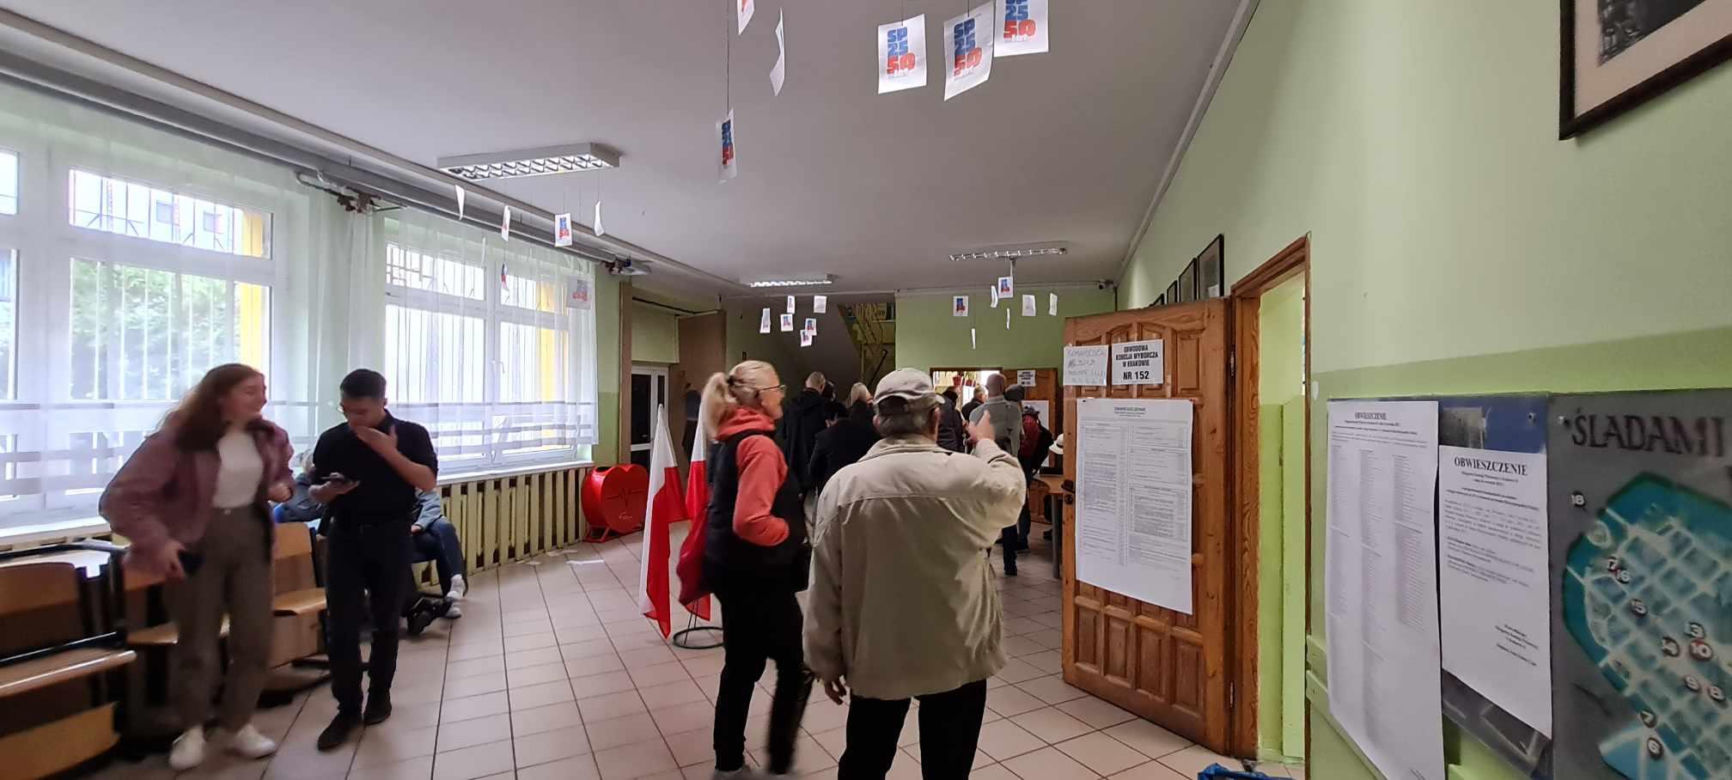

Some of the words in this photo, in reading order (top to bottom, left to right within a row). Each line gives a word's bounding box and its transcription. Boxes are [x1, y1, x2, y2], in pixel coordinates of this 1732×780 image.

[887, 26, 908, 43] SP
[954, 18, 975, 39] SP
[887, 40, 909, 56] 25
[1134, 351, 1159, 359] WYBORCZA
[1123, 372, 1132, 380] NR
[1135, 371, 1149, 380] 152
[1571, 407, 1725, 457] ŚLADAMI
[1454, 456, 1528, 476] OBWIESZCZENIE
[1570, 494, 1585, 505] 18
[1691, 642, 1712, 658] 10
